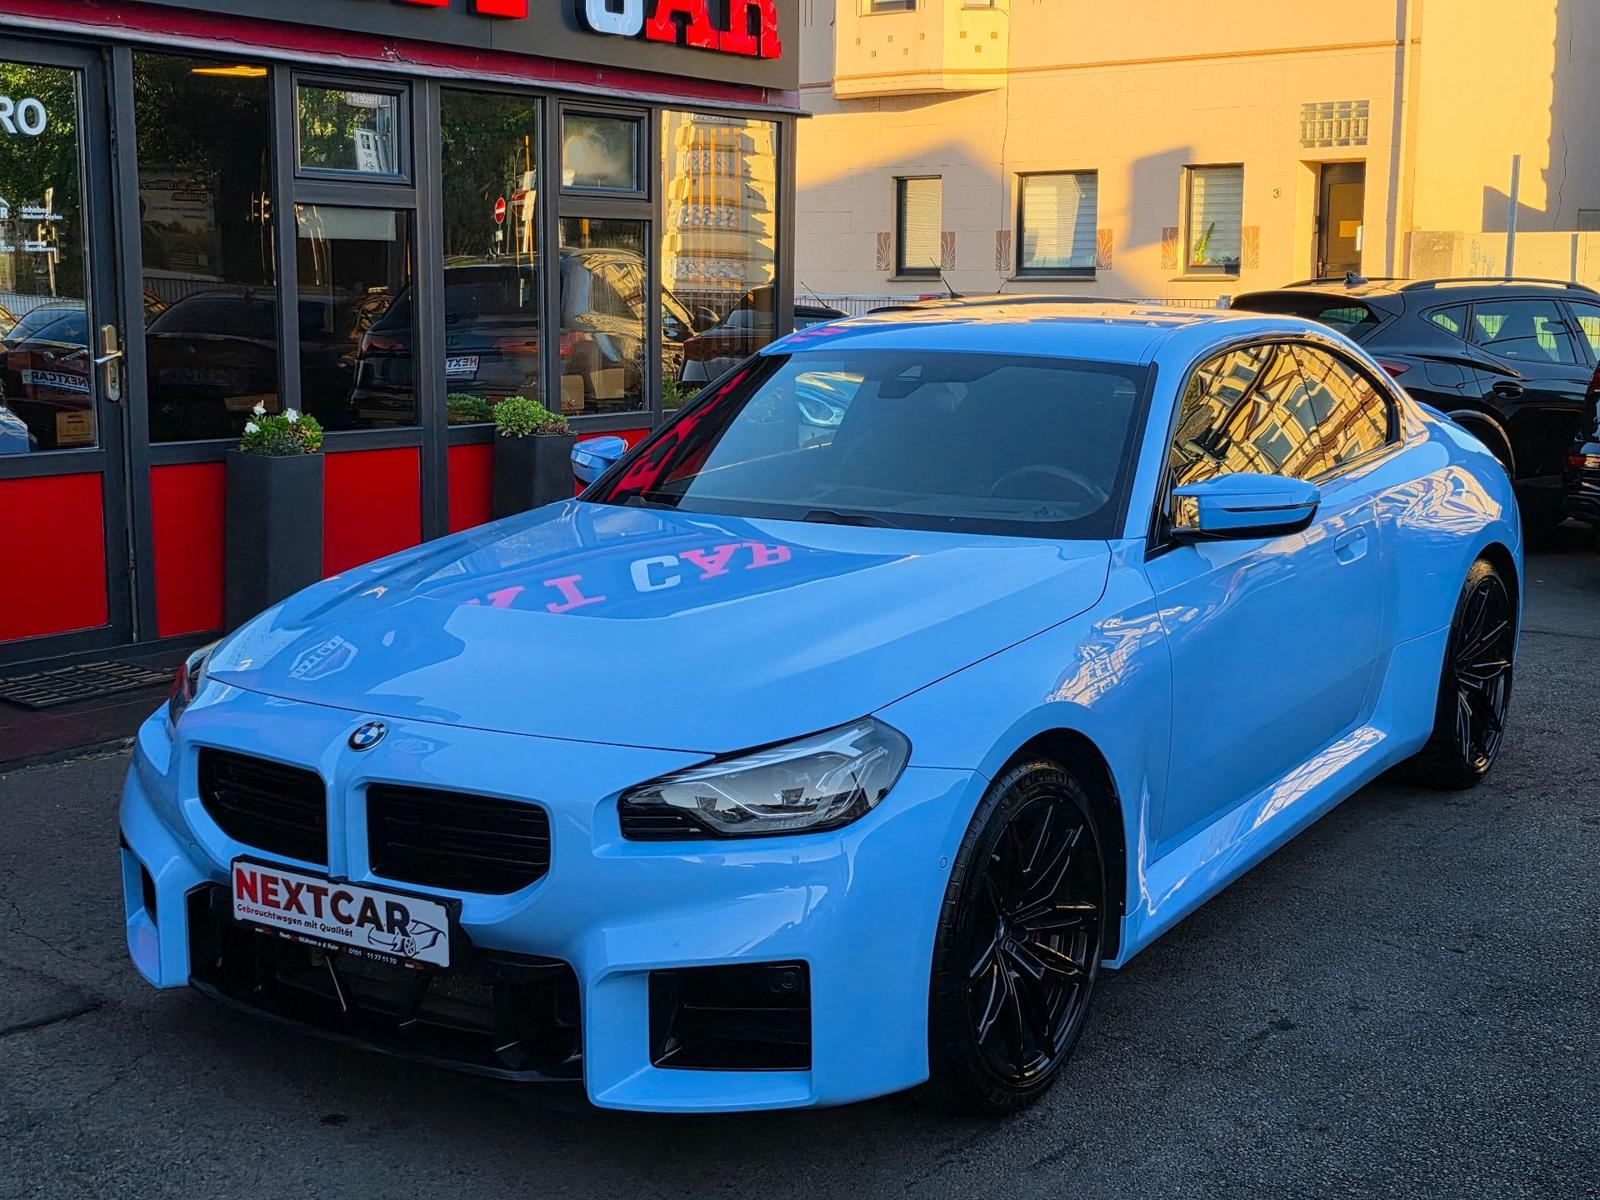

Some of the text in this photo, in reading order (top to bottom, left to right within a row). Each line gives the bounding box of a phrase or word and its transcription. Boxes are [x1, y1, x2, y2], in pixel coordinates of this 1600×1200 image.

[1273, 188, 1280, 199] 3
[236, 868, 412, 938] NEXTCAR
[237, 904, 354, 938] Gebrauchtwagen mit Qualität
